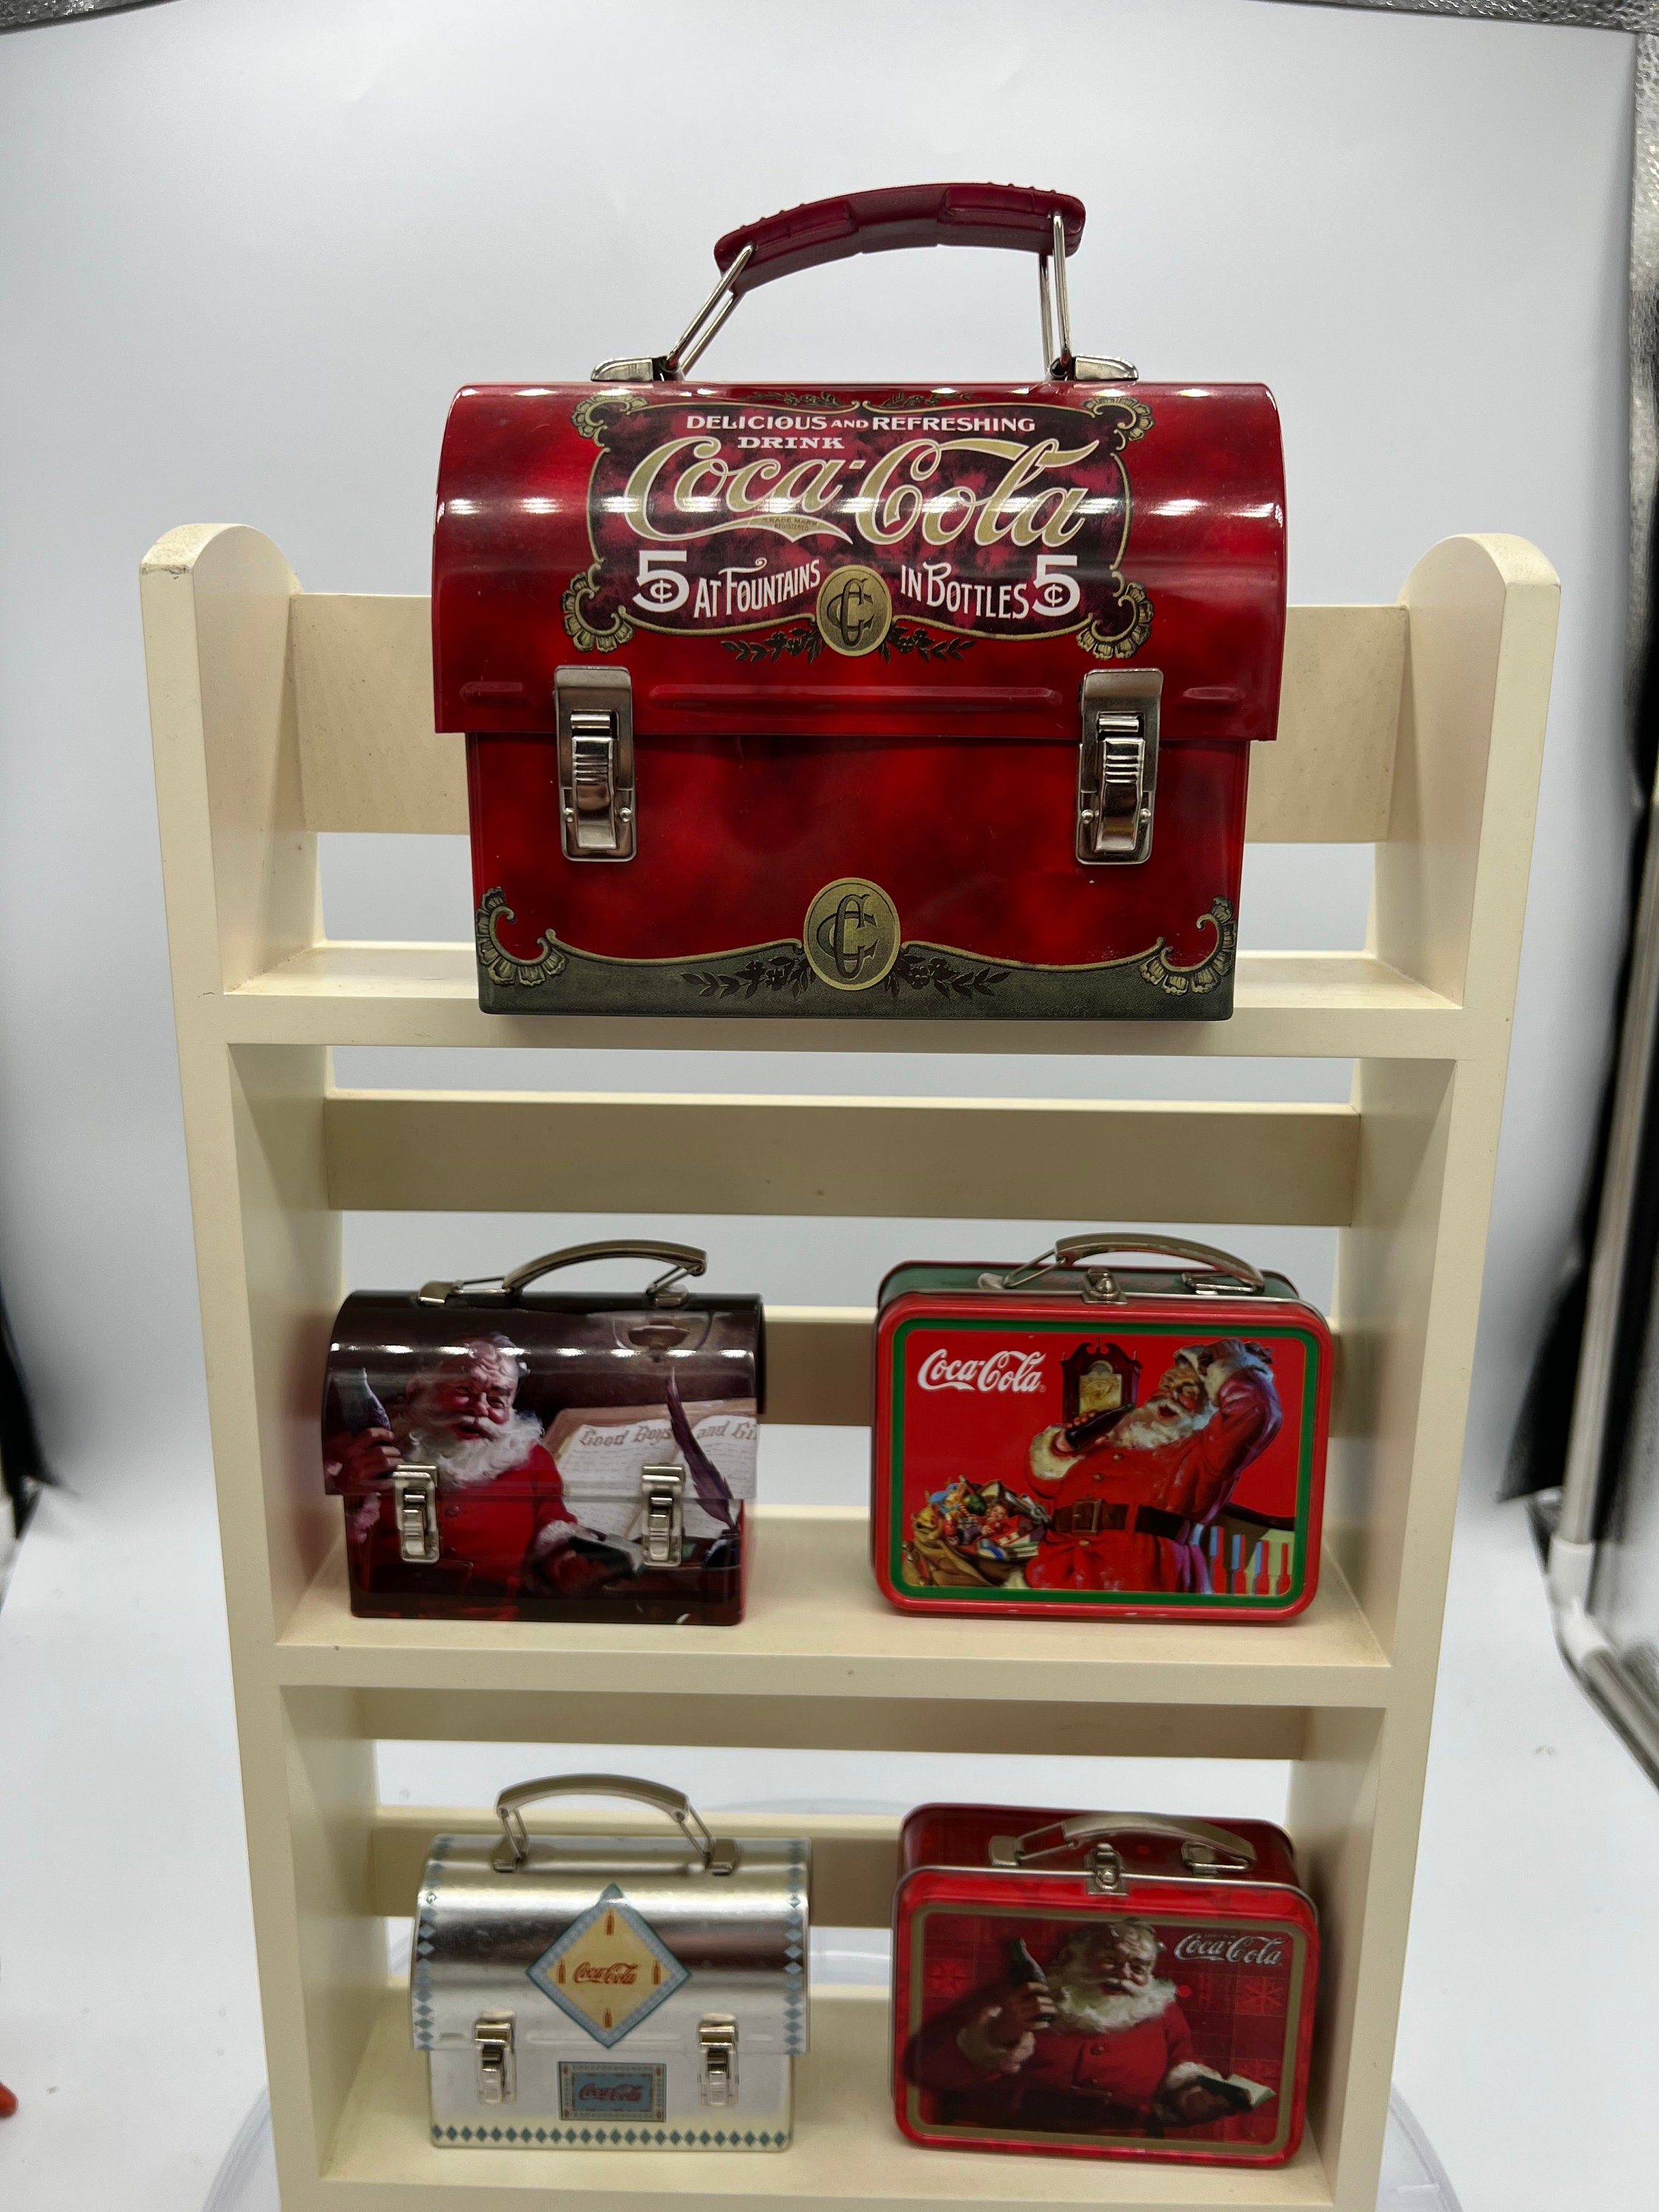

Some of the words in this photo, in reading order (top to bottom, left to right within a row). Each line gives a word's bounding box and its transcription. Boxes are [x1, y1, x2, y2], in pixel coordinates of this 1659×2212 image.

[686, 415, 827, 430] DELICIOUS
[831, 419, 869, 428] AND
[873, 417, 1036, 432] REFRESHING
[737, 437, 845, 449] DRINK
[622, 437, 1099, 546] Coca-Cola
[694, 577, 721, 619] AT
[900, 565, 922, 602] IN
[917, 1349, 1046, 1392] Coca-Cola
[580, 1426, 630, 1446] Good
[633, 1425, 671, 1445] Boys
[697, 1421, 730, 1439] and
[1174, 1933, 1286, 1964] Coca-Cola
[574, 1962, 639, 1983] Coca-Cola
